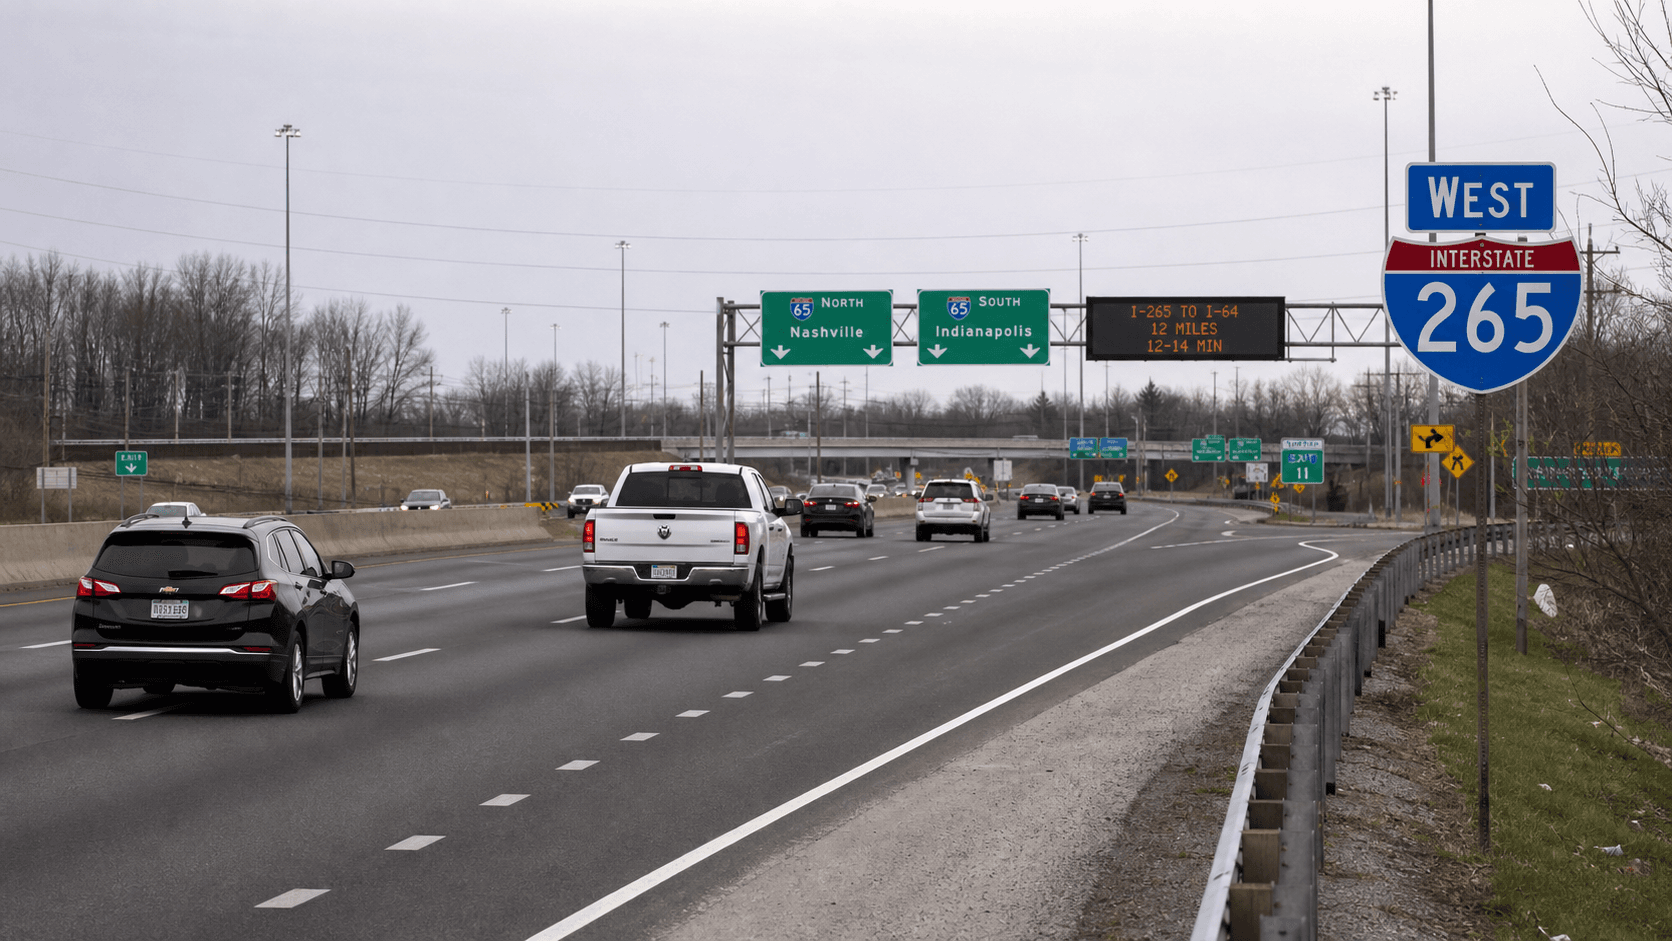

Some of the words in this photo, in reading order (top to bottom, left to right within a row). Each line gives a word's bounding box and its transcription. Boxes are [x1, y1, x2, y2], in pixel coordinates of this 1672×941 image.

[1428, 176, 1534, 218] WEST
[1430, 250, 1535, 268] INTERSTATE
[794, 303, 810, 316] 65
[821, 298, 863, 308] NORTH
[950, 302, 968, 315] 65
[979, 296, 1020, 307] SOUTH
[1131, 305, 1171, 318] I-265
[1181, 305, 1197, 318] TO
[1206, 305, 1238, 318] I-64
[1417, 281, 1553, 353] 265
[790, 326, 863, 338] Nashville
[936, 325, 1032, 339] Indianapolis
[1152, 322, 1168, 335] 12
[1176, 322, 1218, 335] MILES
[1148, 340, 1188, 353] 12-14
[1197, 339, 1222, 353] MIN
[1297, 467, 1308, 480] 11
